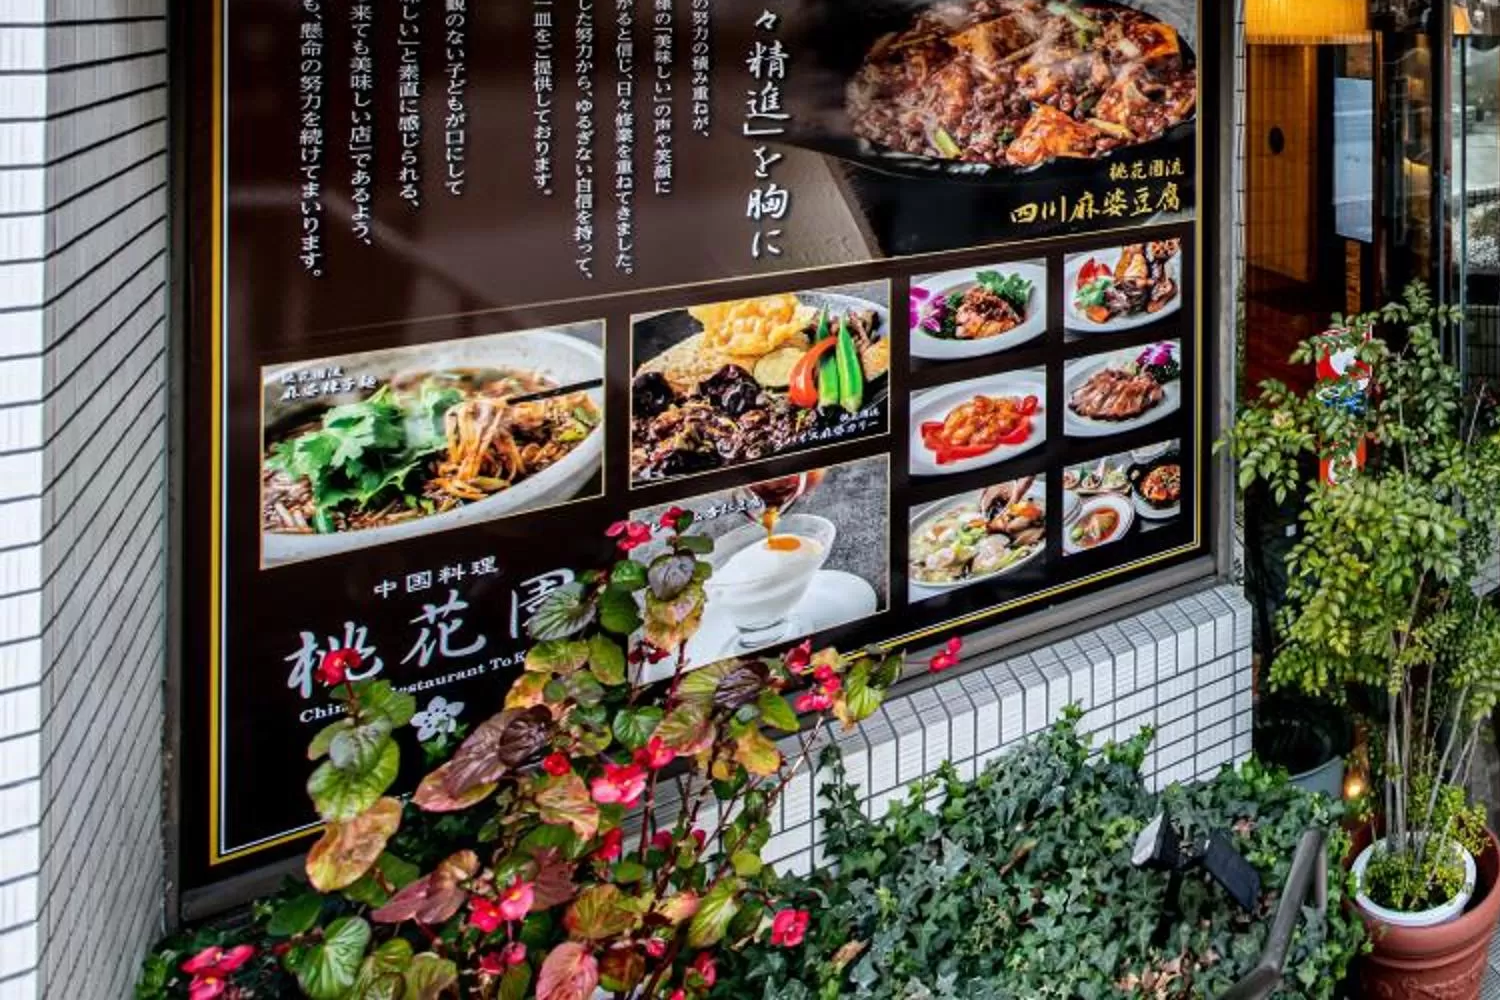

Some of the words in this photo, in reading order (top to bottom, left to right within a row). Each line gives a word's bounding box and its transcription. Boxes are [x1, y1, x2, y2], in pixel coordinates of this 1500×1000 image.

[1010, 182, 1181, 223] 四川麻婆豆腐
[373, 555, 499, 598] 中国料理
